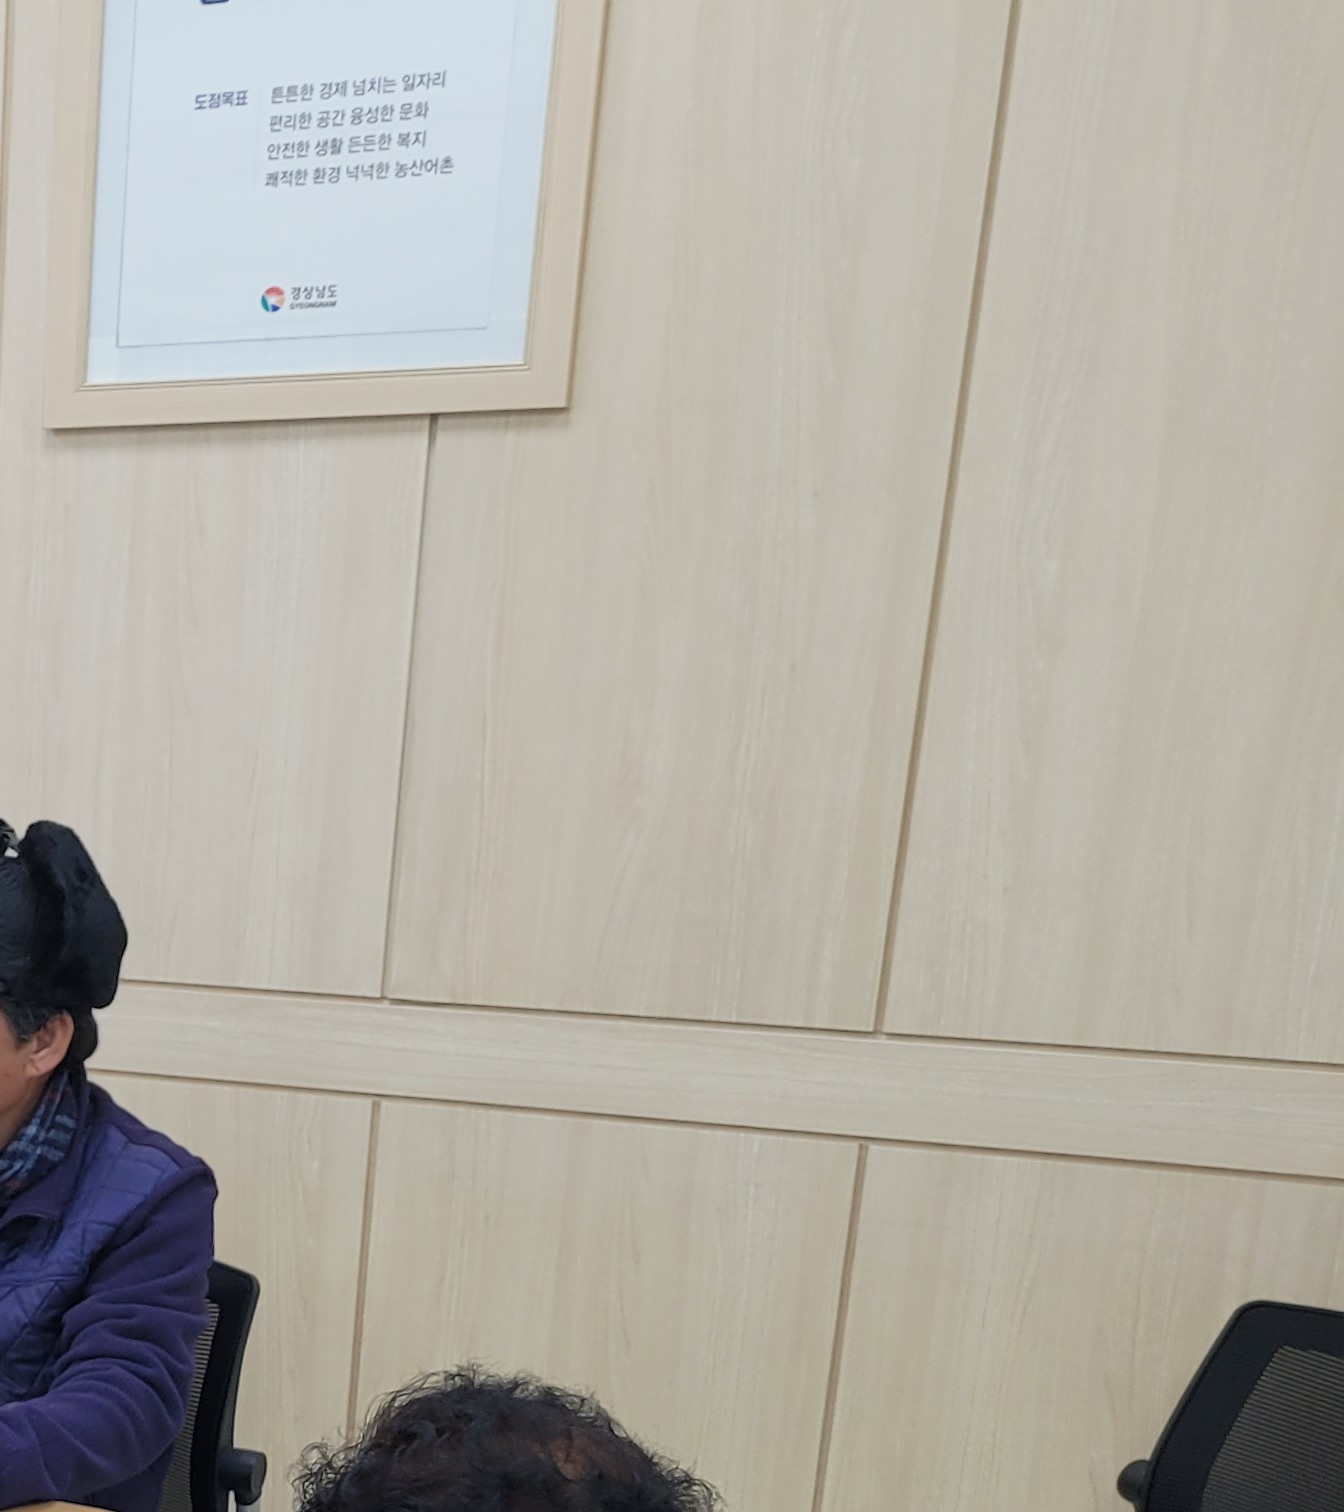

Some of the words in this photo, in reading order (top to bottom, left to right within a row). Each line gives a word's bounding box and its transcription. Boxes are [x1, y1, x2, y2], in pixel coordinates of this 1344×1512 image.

[271, 83, 314, 104] 튼튼한
[319, 80, 348, 100] 경제
[353, 76, 396, 96] 넘치는
[401, 70, 447, 91] 일자리
[270, 112, 312, 132] 편리한
[316, 109, 346, 128] 공간
[350, 104, 394, 125] 융성한
[399, 101, 429, 120] 문화
[267, 141, 310, 160] 안전한
[314, 138, 343, 156] 생활
[348, 133, 392, 152] 든든한
[396, 130, 427, 148] 복지
[265, 168, 308, 187] 쾌적한
[313, 166, 341, 184] 환경
[346, 162, 389, 181] 넉넉한
[394, 156, 454, 178] 농산어촌
[291, 285, 338, 301] 경상남도
